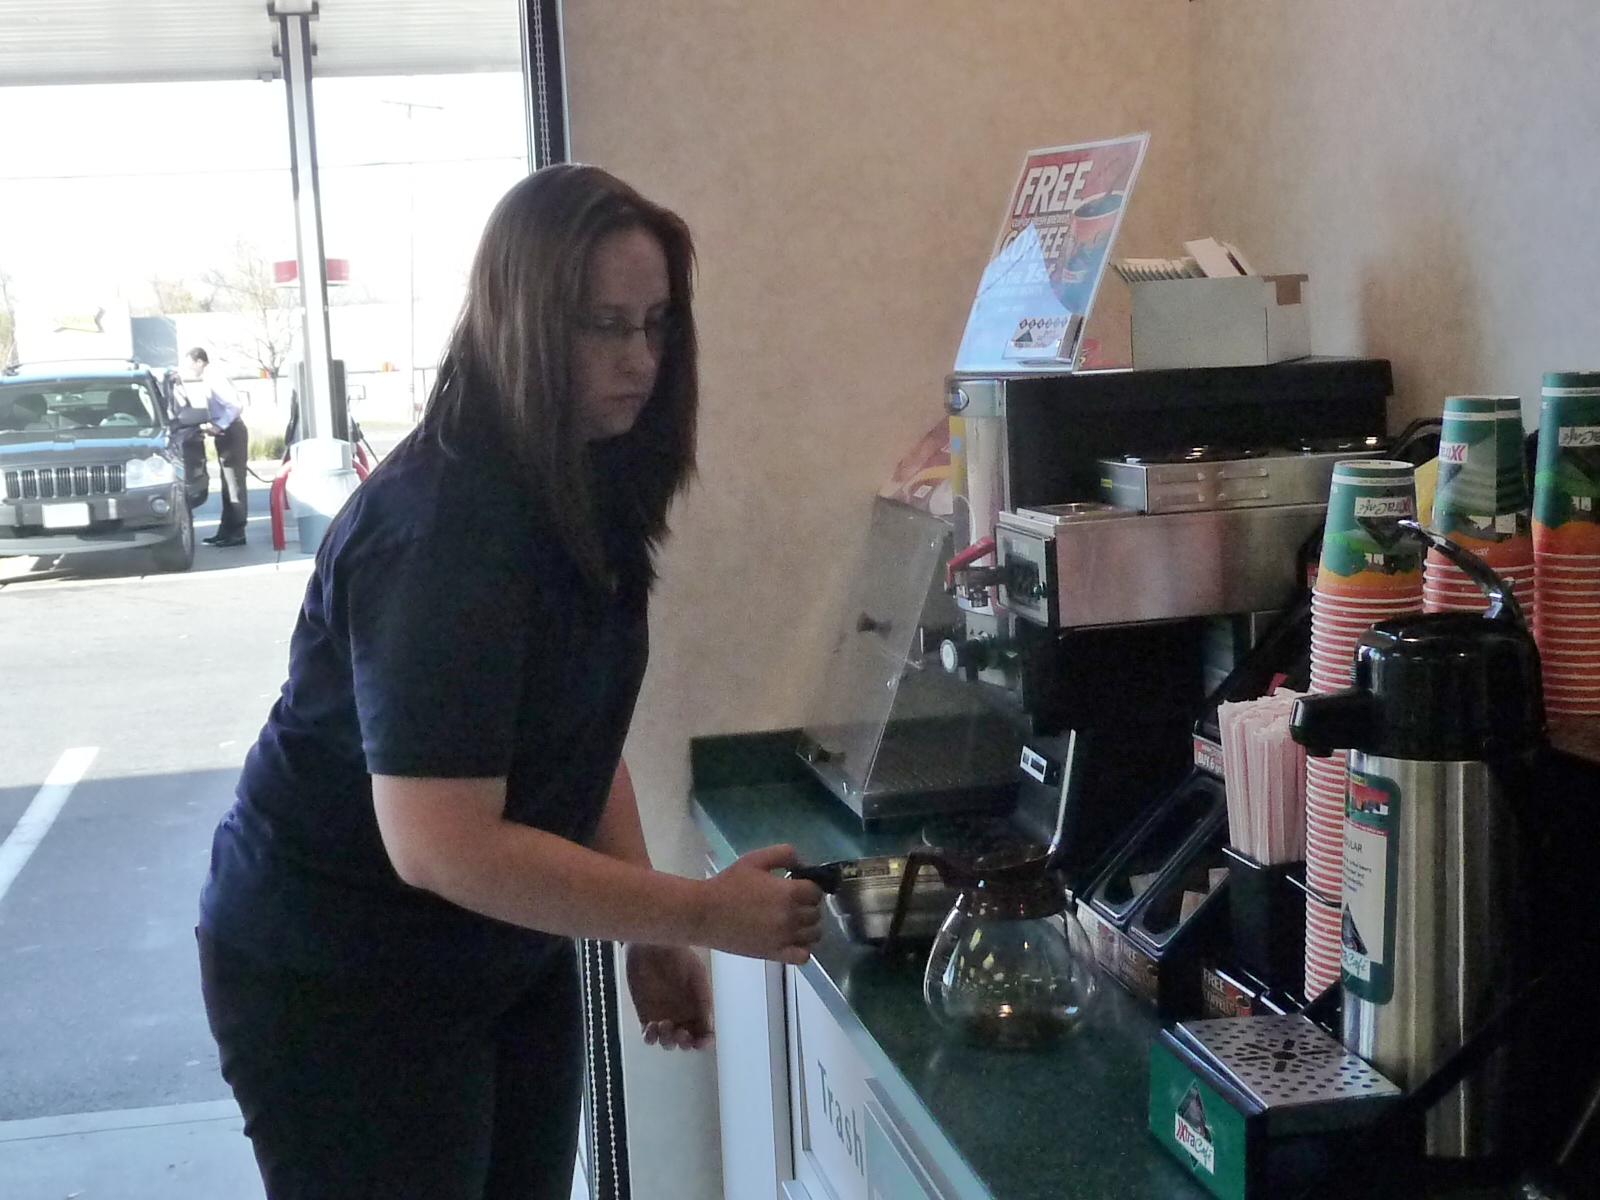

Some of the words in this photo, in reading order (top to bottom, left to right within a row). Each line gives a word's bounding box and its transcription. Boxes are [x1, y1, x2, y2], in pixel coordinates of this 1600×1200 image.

[1013, 160, 1094, 216] FREE
[999, 226, 1069, 262] COFFEE
[1203, 967, 1226, 994] FREE
[817, 1059, 864, 1176] Trash
